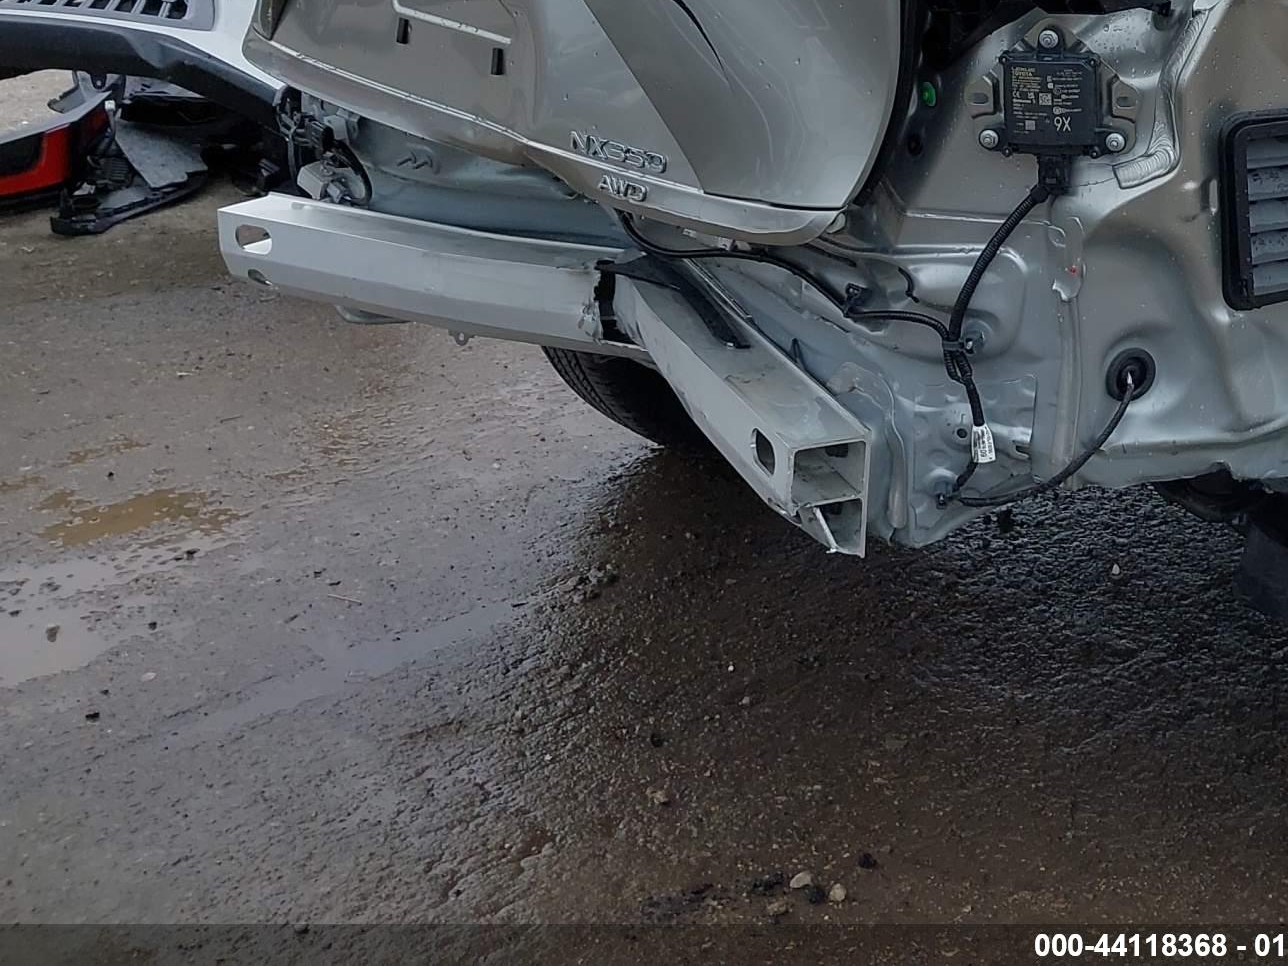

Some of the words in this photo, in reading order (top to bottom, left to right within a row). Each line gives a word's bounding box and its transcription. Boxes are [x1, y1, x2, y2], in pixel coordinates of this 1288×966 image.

[1054, 116, 1072, 132] 9X
[569, 130, 668, 174] NX350
[598, 174, 649, 202] AWD
